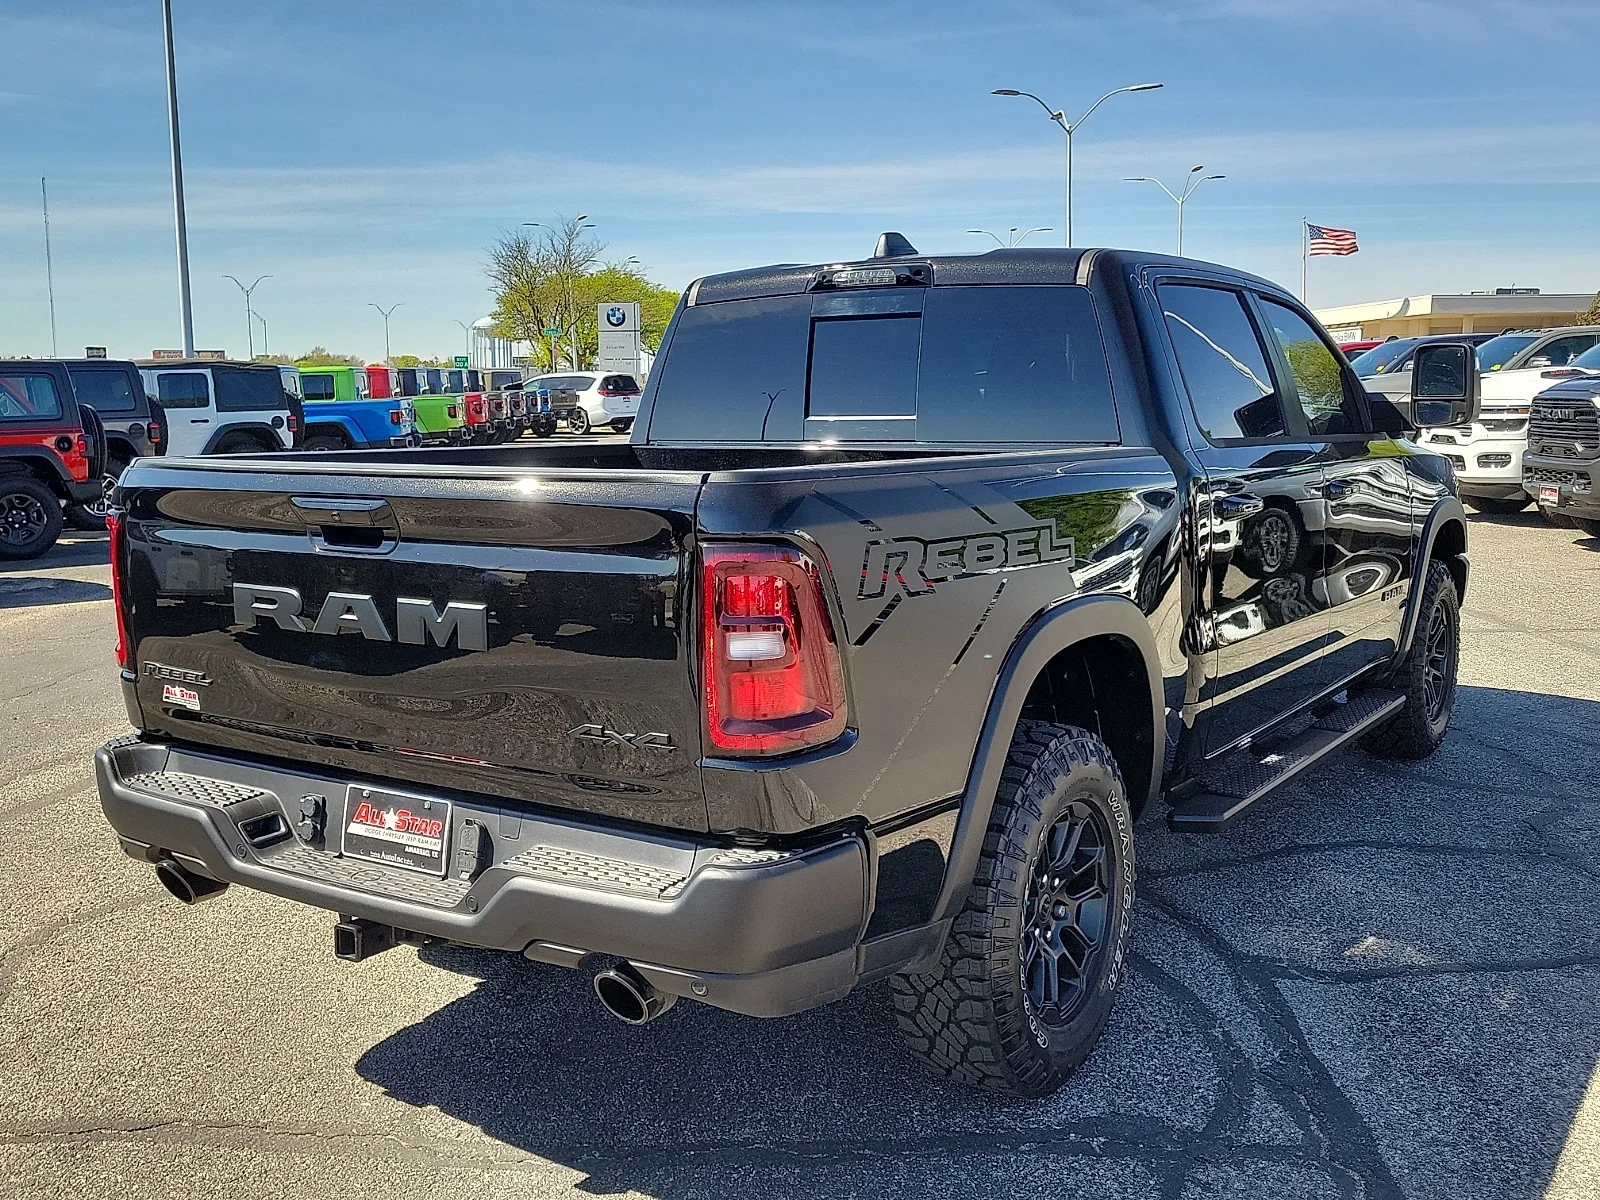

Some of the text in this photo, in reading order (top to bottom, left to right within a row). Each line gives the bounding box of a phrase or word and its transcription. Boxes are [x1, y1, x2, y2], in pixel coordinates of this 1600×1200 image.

[857, 525, 1073, 601] REBEL
[232, 582, 488, 651] RAM
[143, 660, 214, 687] REBEL
[165, 686, 197, 701] ALL STAR
[353, 802, 443, 838] ALL STAR
[364, 827, 381, 836] DODGE
[382, 831, 405, 841] CHRYSLER
[417, 837, 429, 846] RAM
[1108, 788, 1133, 991] WRANGLER
